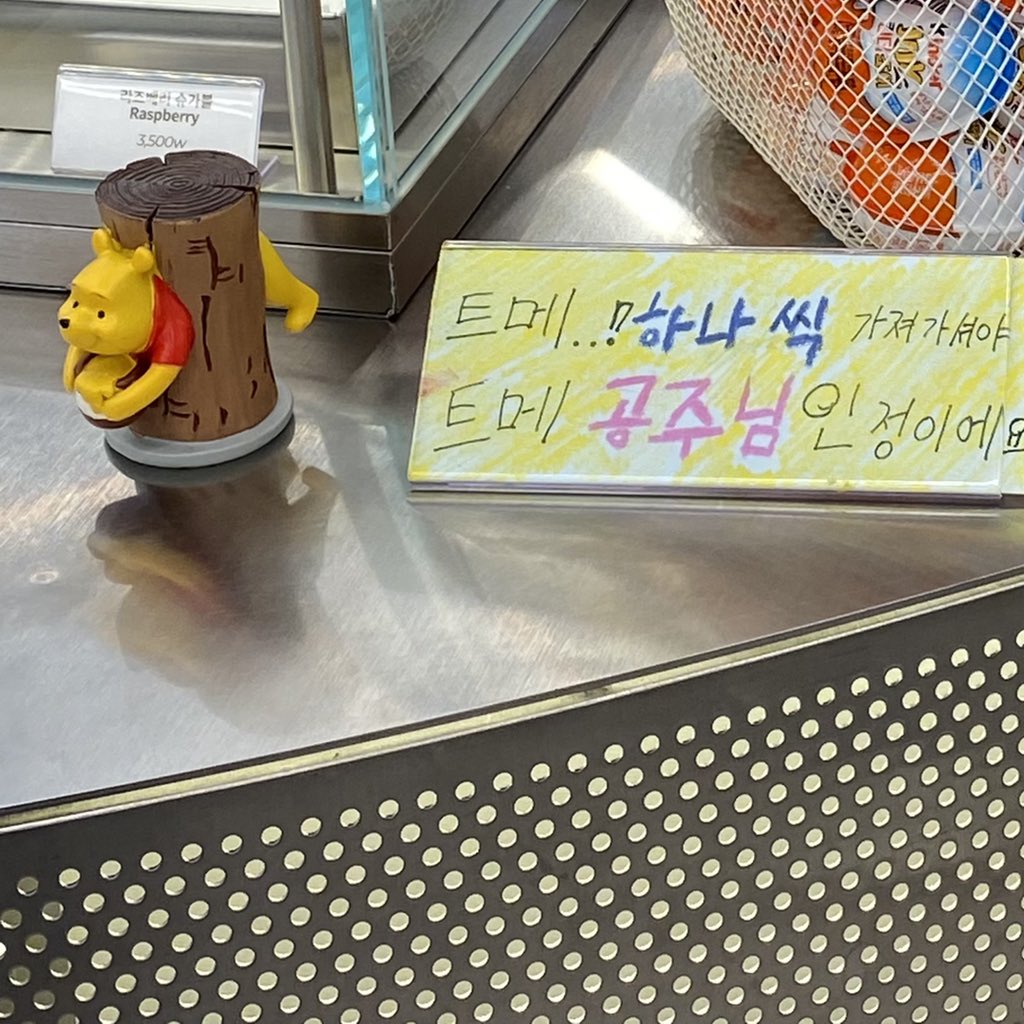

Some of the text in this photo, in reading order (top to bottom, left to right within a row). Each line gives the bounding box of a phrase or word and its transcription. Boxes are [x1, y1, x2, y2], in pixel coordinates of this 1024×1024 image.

[129, 107, 200, 126] Raspberry
[433, 380, 571, 451] 트메
[589, 375, 796, 459] 공주님
